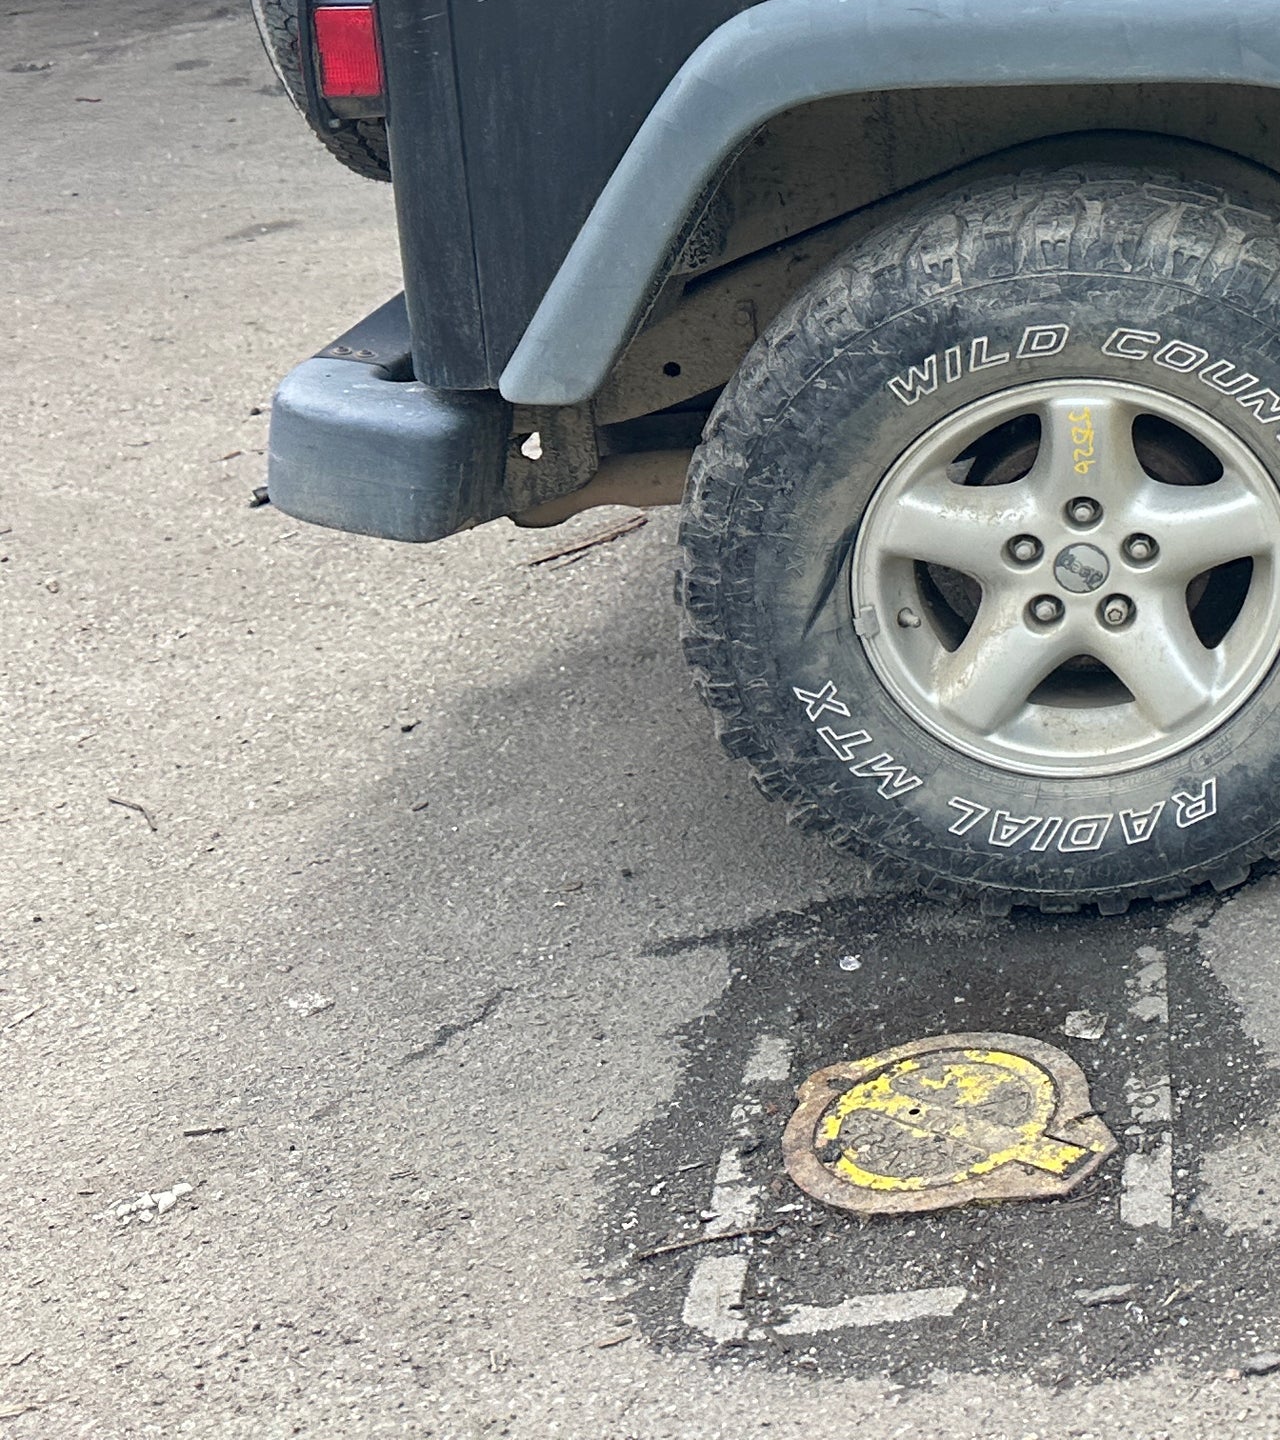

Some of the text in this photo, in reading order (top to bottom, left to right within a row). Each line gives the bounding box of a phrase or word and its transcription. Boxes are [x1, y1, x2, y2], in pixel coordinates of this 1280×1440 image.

[887, 323, 1069, 406] WILD
[792, 680, 1218, 853] RADIAL MTX
